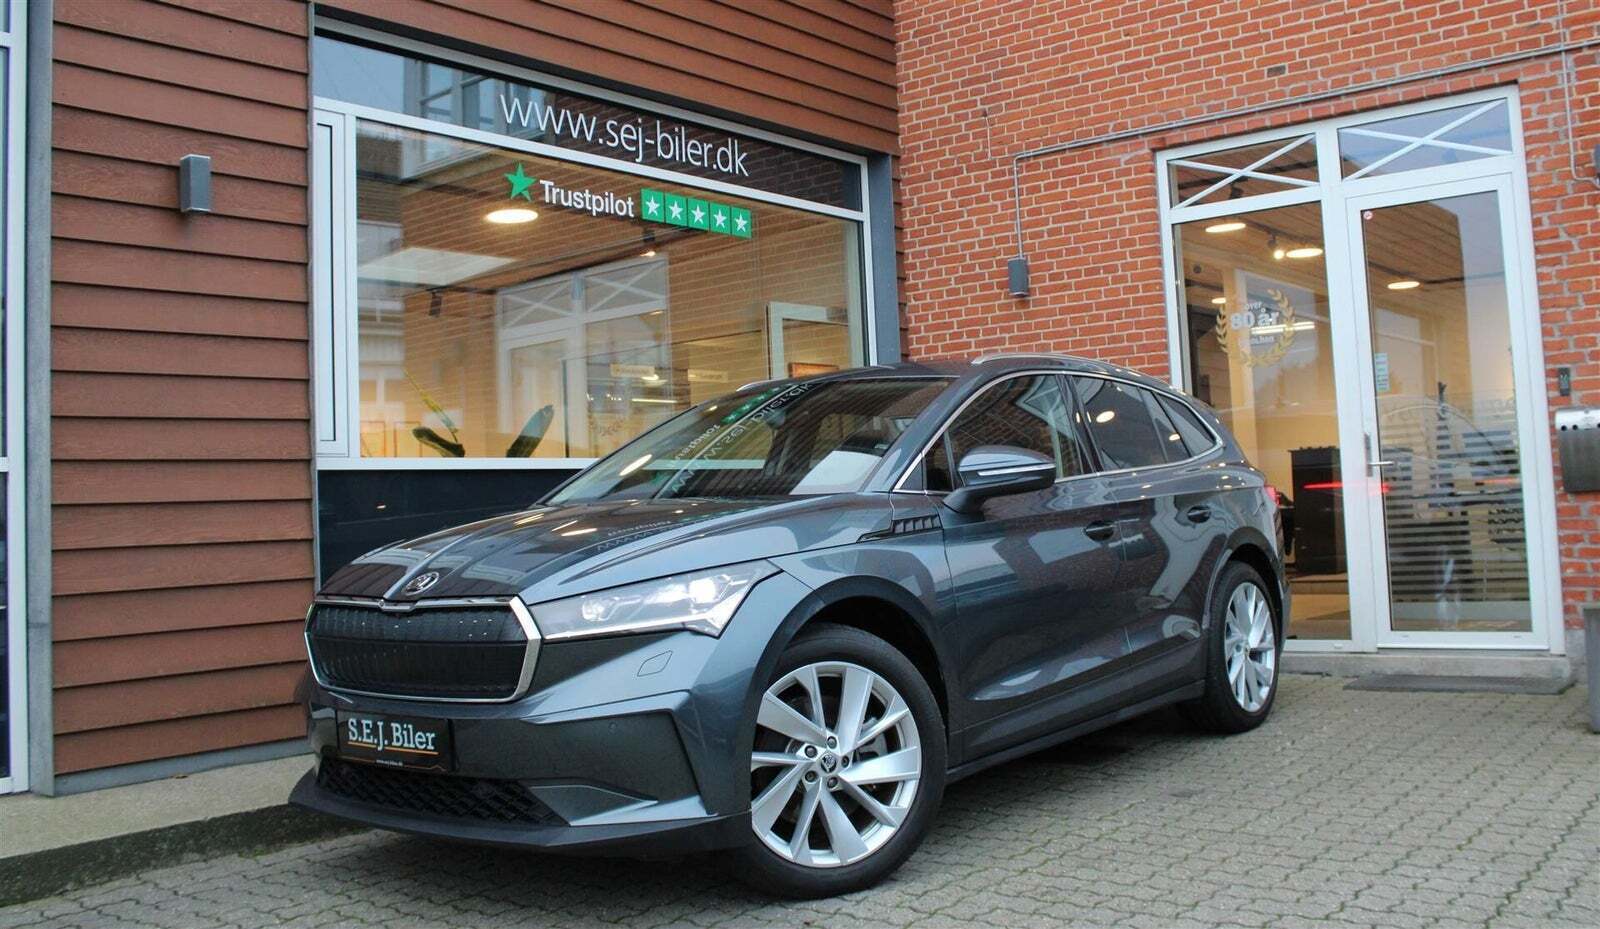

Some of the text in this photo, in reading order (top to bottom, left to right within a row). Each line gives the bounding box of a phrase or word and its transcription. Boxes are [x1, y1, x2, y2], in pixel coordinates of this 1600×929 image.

[500, 94, 749, 177] www.sej-biler.dk
[539, 179, 635, 218] Trustpilot
[347, 718, 436, 752] S.E.J. Biler
